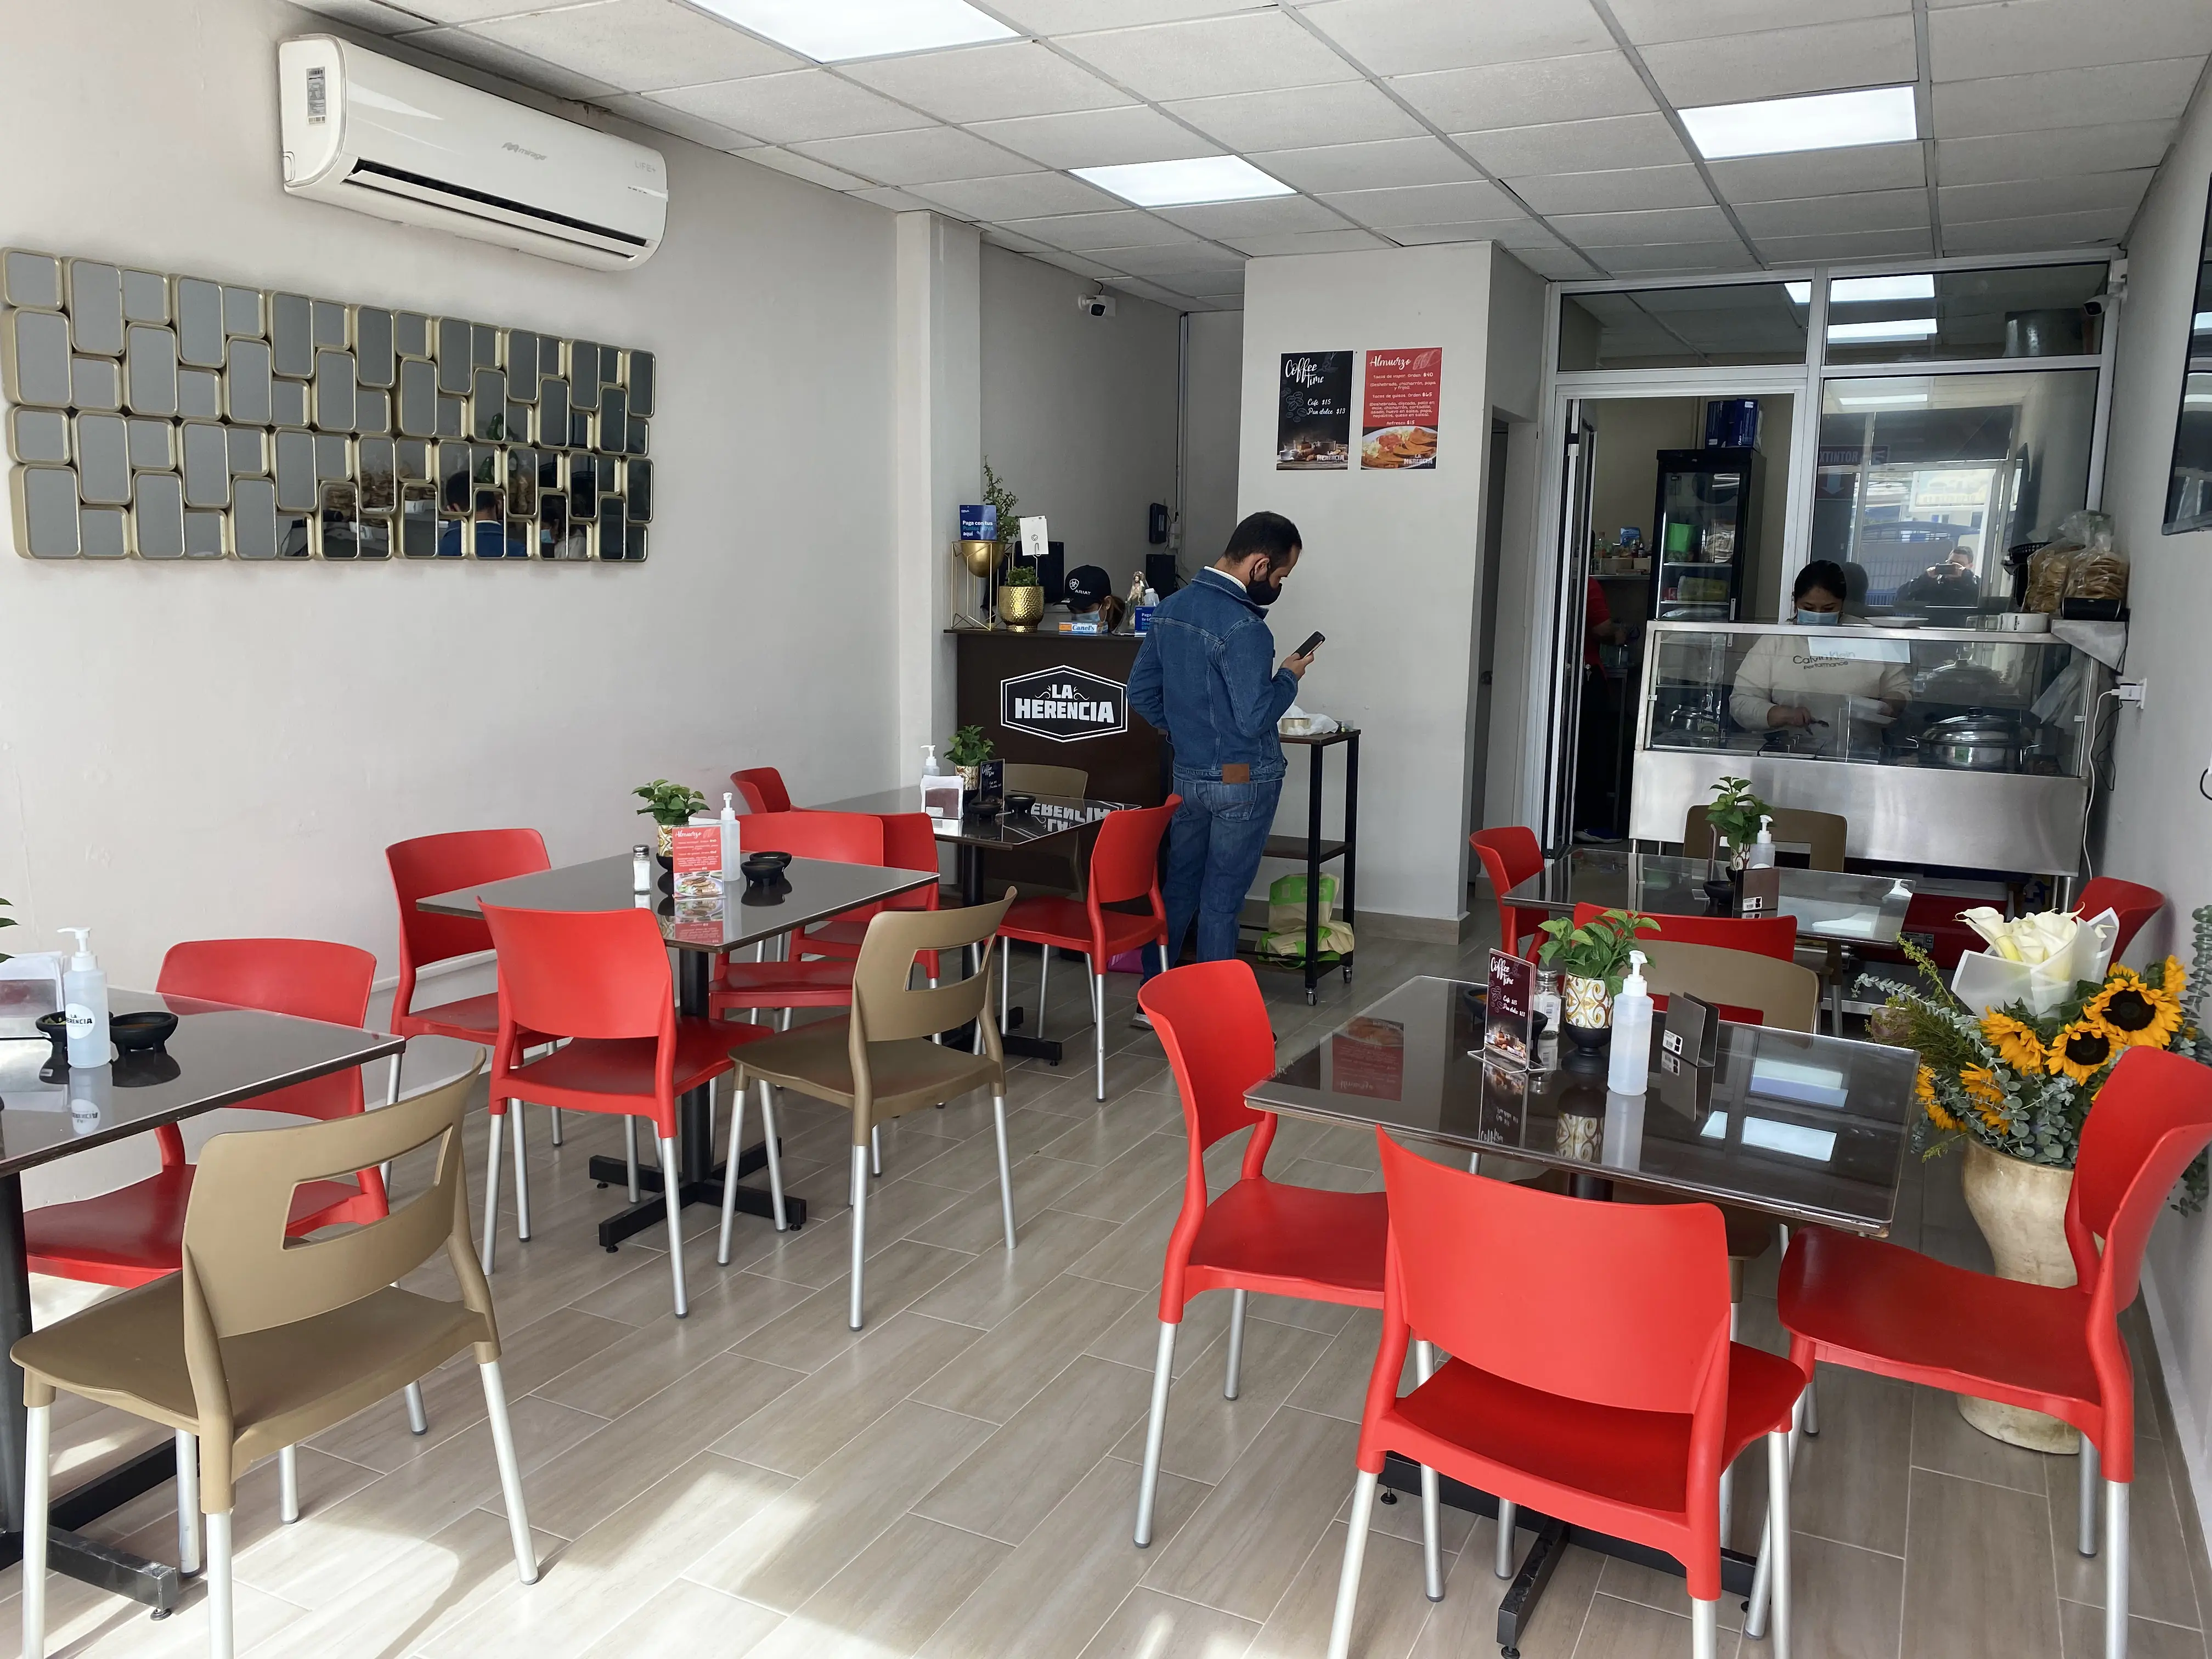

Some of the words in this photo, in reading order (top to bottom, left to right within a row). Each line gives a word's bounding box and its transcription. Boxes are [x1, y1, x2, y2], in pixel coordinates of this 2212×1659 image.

[1285, 357, 1317, 383] Coffee
[1369, 354, 1412, 370] Almuerzo
[1819, 450, 1859, 463] XTINTOR
[1052, 684, 1073, 699] LA
[1015, 697, 1114, 724] HERENCIA
[1491, 957, 1510, 980] Coffee
